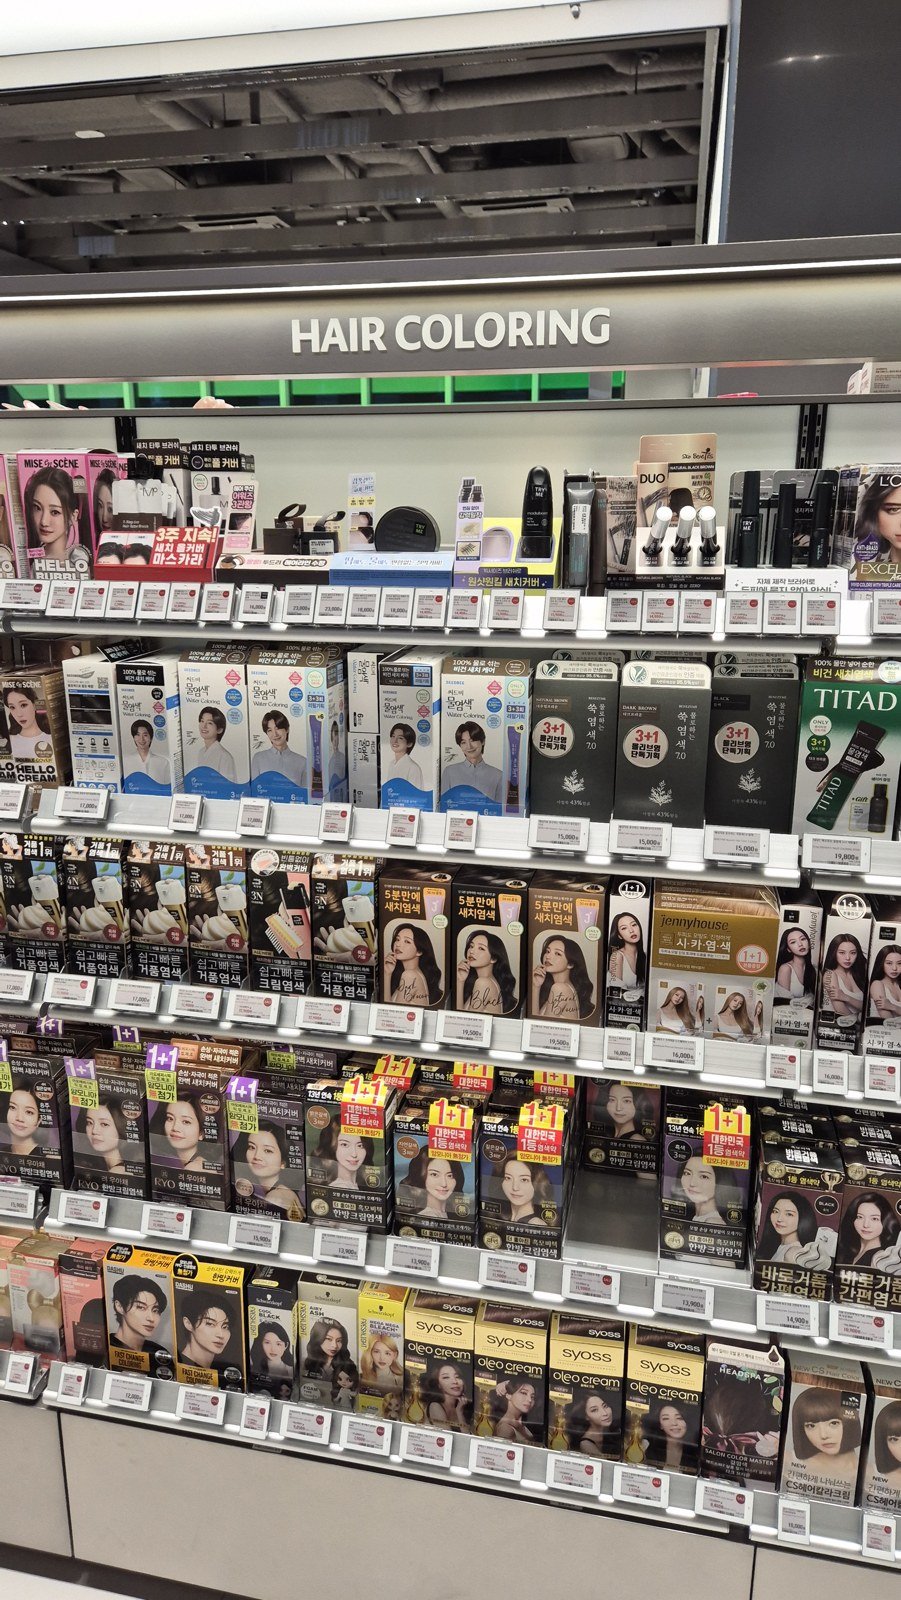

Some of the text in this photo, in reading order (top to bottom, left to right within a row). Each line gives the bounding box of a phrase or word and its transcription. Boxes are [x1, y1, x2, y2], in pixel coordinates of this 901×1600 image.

[291, 307, 611, 353] HAIR COLORING
[219, 444, 239, 452] 브러쉬
[24, 459, 43, 468] MISE
[222, 457, 239, 468] 커버
[640, 473, 666, 484] DUO
[156, 528, 218, 543] 3주 지속!
[155, 543, 173, 553] 새치
[34, 558, 88, 572] HELLO
[152, 554, 203, 566] 마스카라
[504, 577, 540, 587] 새치커버
[812, 668, 832, 678] 비건
[185, 682, 210, 698] 물염색
[252, 686, 278, 700] 물염색
[445, 696, 474, 710] 물염색
[814, 688, 898, 712] TITAD
[462, 712, 486, 720] Coloring
[543, 722, 565, 735] 3+1
[725, 726, 749, 740] 3+1
[539, 734, 567, 743] 올리브영
[634, 729, 658, 743] 3+1
[539, 742, 567, 751] 단독기획
[631, 743, 661, 752] 올리브영
[722, 740, 751, 749] 올리브영
[811, 738, 826, 747] 3+1
[630, 751, 660, 760] 단독기획
[722, 747, 751, 756] 단독기획
[16, 764, 55, 774] HELLO
[18, 774, 56, 782] CREAM
[816, 776, 842, 811] TITAD
[24, 840, 36, 848] 거품
[23, 848, 38, 856] 염색
[212, 850, 226, 858] 거품
[212, 857, 227, 866] 염색
[281, 854, 310, 864] 빈틈없이
[280, 863, 308, 873] 완벽커버
[624, 884, 641, 892] 1+1
[384, 890, 421, 901] 5분만에
[458, 895, 496, 909] 5분만에
[534, 900, 573, 913] 5분만에
[842, 900, 859, 910] 1+1
[384, 903, 421, 914] 새치염색
[458, 908, 495, 921] 새치염색
[534, 913, 572, 925] 새치염색
[15, 947, 58, 959] 쉽고빠른
[75, 949, 119, 963] 쉽고빠른
[742, 951, 762, 960] 1+1
[138, 952, 181, 967] 쉽고빠른
[197, 958, 241, 972] 쉽고빠른
[18, 959, 60, 973] 거품염색
[77, 962, 119, 976] 거품염색
[138, 964, 182, 979] 거품염색
[259, 965, 305, 979] 쉽고빠른
[197, 970, 241, 986] 거품염색
[321, 971, 367, 986] 쉽고빠른
[259, 977, 305, 993] 크림염색
[320, 982, 367, 999] 거품염색
[469, 988, 504, 1008] Black
[149, 1045, 179, 1070] 1+1
[66, 1058, 96, 1078] 1+1
[148, 1082, 175, 1092] 암모니아
[229, 1078, 258, 1102] 1+1
[350, 1076, 381, 1104] 1+1
[346, 1106, 377, 1117] 대한민국
[435, 1099, 466, 1128] 1+1
[526, 1103, 557, 1129] 1+1
[344, 1114, 359, 1125] 1등
[709, 1105, 744, 1134] 1+1
[435, 1128, 466, 1139] 대한민국
[524, 1130, 556, 1141] 대한민국
[432, 1136, 447, 1148] 1등
[521, 1138, 536, 1151] 1등
[711, 1135, 744, 1147] 대한민국
[707, 1143, 724, 1156] 1등
[609, 1157, 656, 1170] 한방크림염색
[20, 1167, 60, 1178] 한방크림염색
[154, 1178, 176, 1189] RYO
[178, 1183, 222, 1195] 한방크림염색
[102, 1185, 143, 1197] 한방크림염색
[334, 1210, 382, 1223] 한방크림염색
[506, 1243, 558, 1258] 한방크림염색
[688, 1243, 743, 1258] 한방크림염색
[107, 1265, 125, 1274] DASHU
[212, 1273, 240, 1284] 한방커버
[762, 1265, 827, 1290] 바로거품
[175, 1280, 194, 1290] DASHU
[442, 1303, 474, 1314] syoss
[258, 1312, 281, 1320] BLACK
[513, 1317, 545, 1327] syoss
[416, 1320, 463, 1336] syoss
[588, 1329, 622, 1339] syoss
[487, 1334, 535, 1350] syoss
[667, 1341, 701, 1352] syoss
[114, 1351, 145, 1363] FAST CHANGE
[408, 1342, 471, 1360] oleo cream
[562, 1348, 612, 1363] syoss
[118, 1358, 142, 1369] COLORING
[478, 1357, 543, 1375] oleo cream
[640, 1360, 691, 1377] syoss
[182, 1368, 213, 1380] FAST CHANGE
[553, 1371, 620, 1388] oleo cream
[719, 1367, 762, 1381] HEADSPA
[630, 1382, 698, 1402] oleo cream
[705, 1448, 774, 1466] SALON COLOR MASTER
[791, 1461, 807, 1470] NEW
[872, 1475, 889, 1484] NEW
[785, 1480, 850, 1500] CS헤어칼라크림
